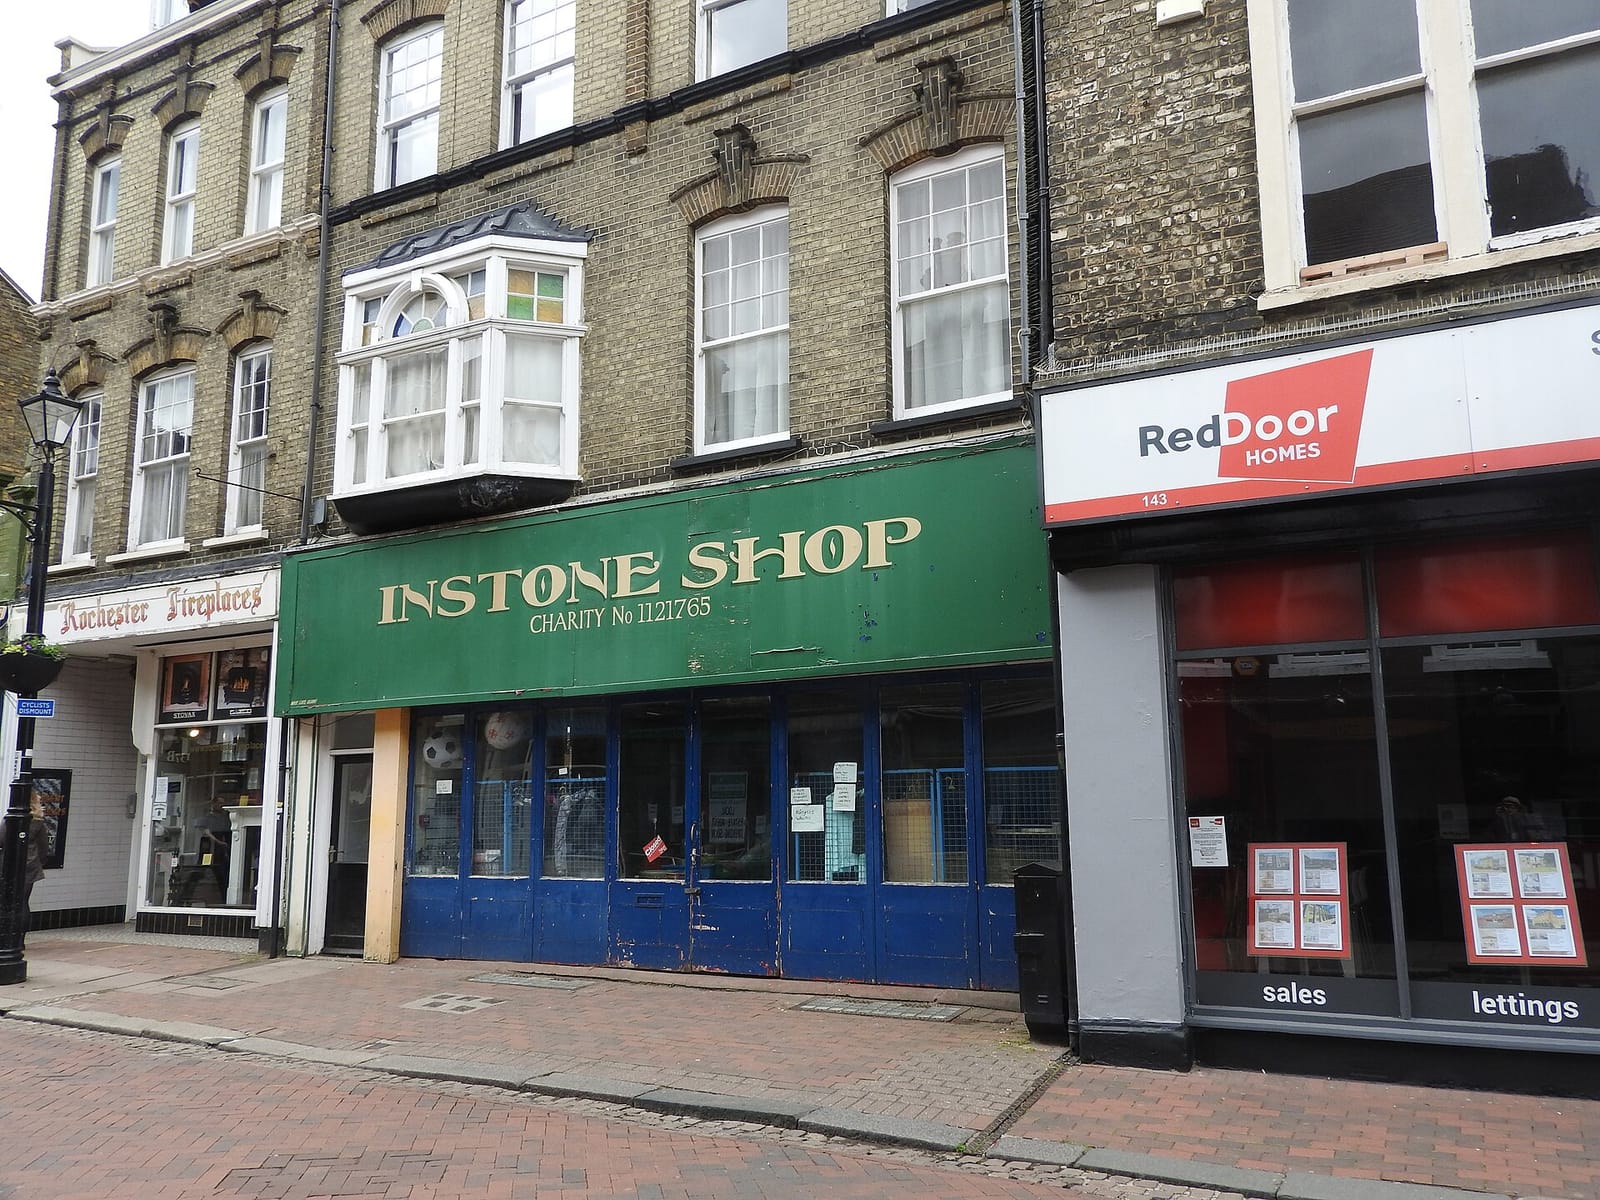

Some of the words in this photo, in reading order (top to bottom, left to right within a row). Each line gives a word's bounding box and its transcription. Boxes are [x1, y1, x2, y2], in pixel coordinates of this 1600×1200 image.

[1139, 403, 1339, 457] RedDoor
[1245, 442, 1321, 467] HOMES
[1142, 493, 1168, 508] 143
[378, 551, 660, 625] INSTONE
[681, 517, 922, 590] SHOP
[60, 597, 150, 634] Rochester
[166, 581, 263, 621] Fireplaces
[530, 608, 607, 634] CHARITY
[612, 608, 633, 625] No
[637, 596, 711, 624] 1121765
[18, 708, 52, 716] DISMOUNT
[1263, 982, 1327, 1005] sales
[1472, 991, 1580, 1023] lettings
